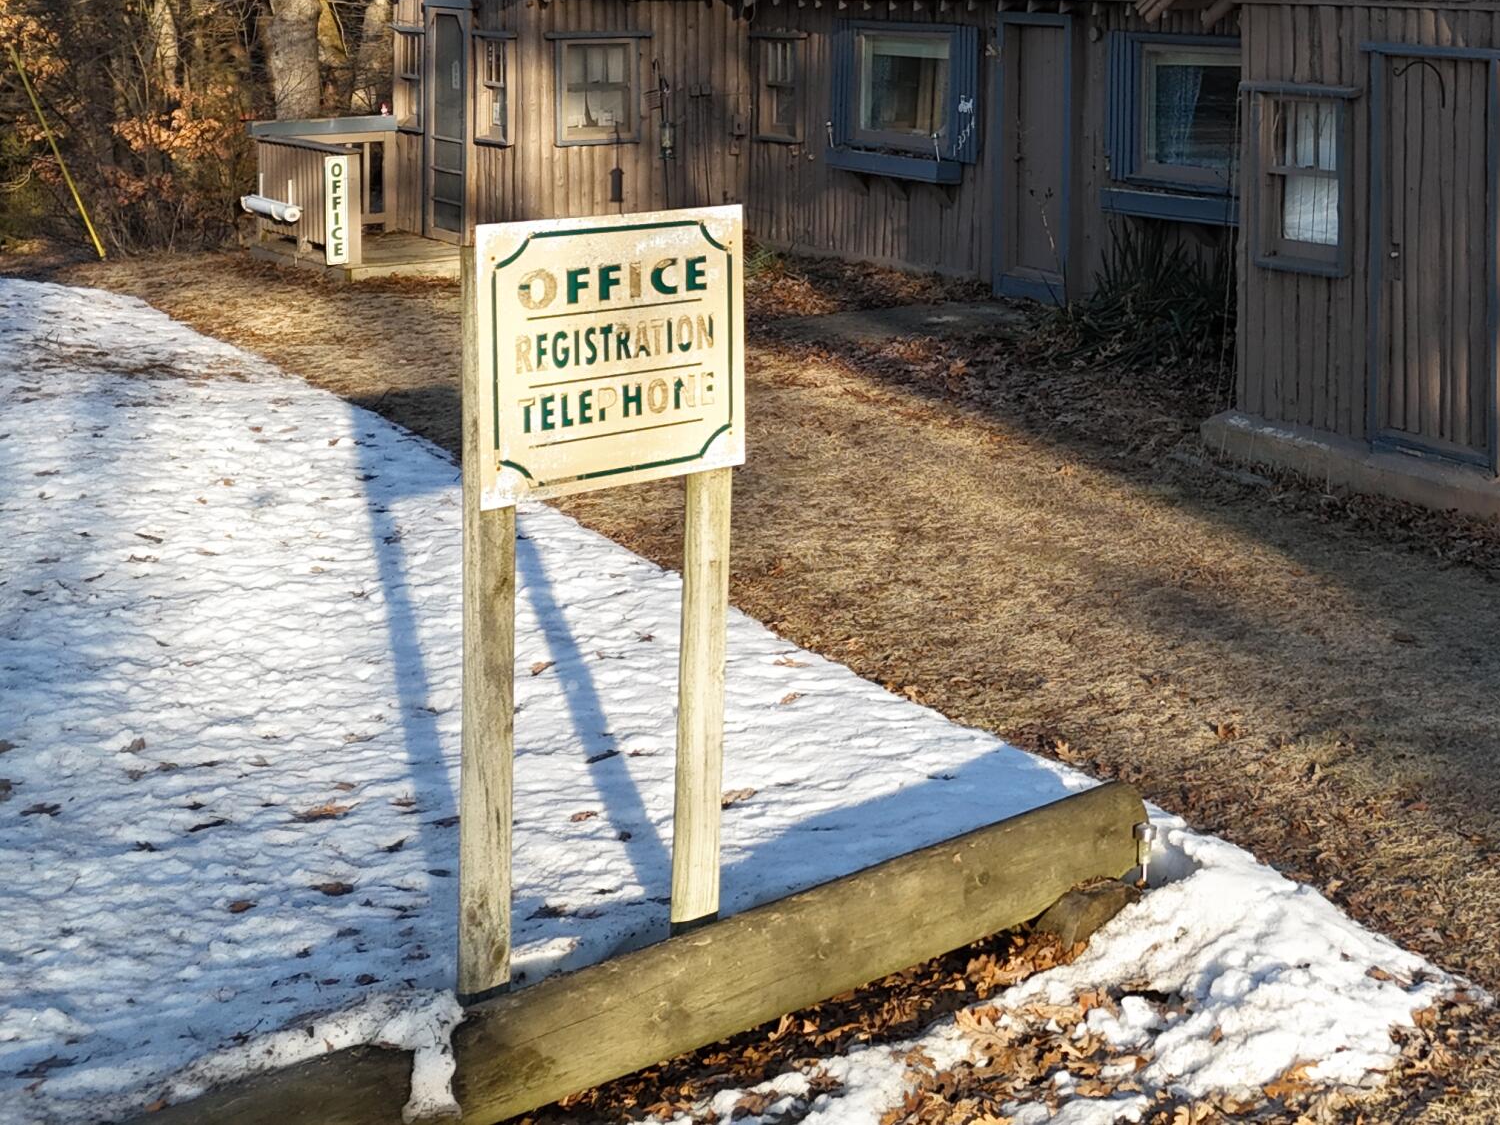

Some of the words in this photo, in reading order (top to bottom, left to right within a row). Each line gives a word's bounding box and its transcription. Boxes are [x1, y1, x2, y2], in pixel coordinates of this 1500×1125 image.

[331, 162, 344, 257] OFFICE
[516, 254, 707, 310] OFFICE
[514, 313, 714, 375] REGISTRATION
[517, 371, 715, 434] TELEPHONE
